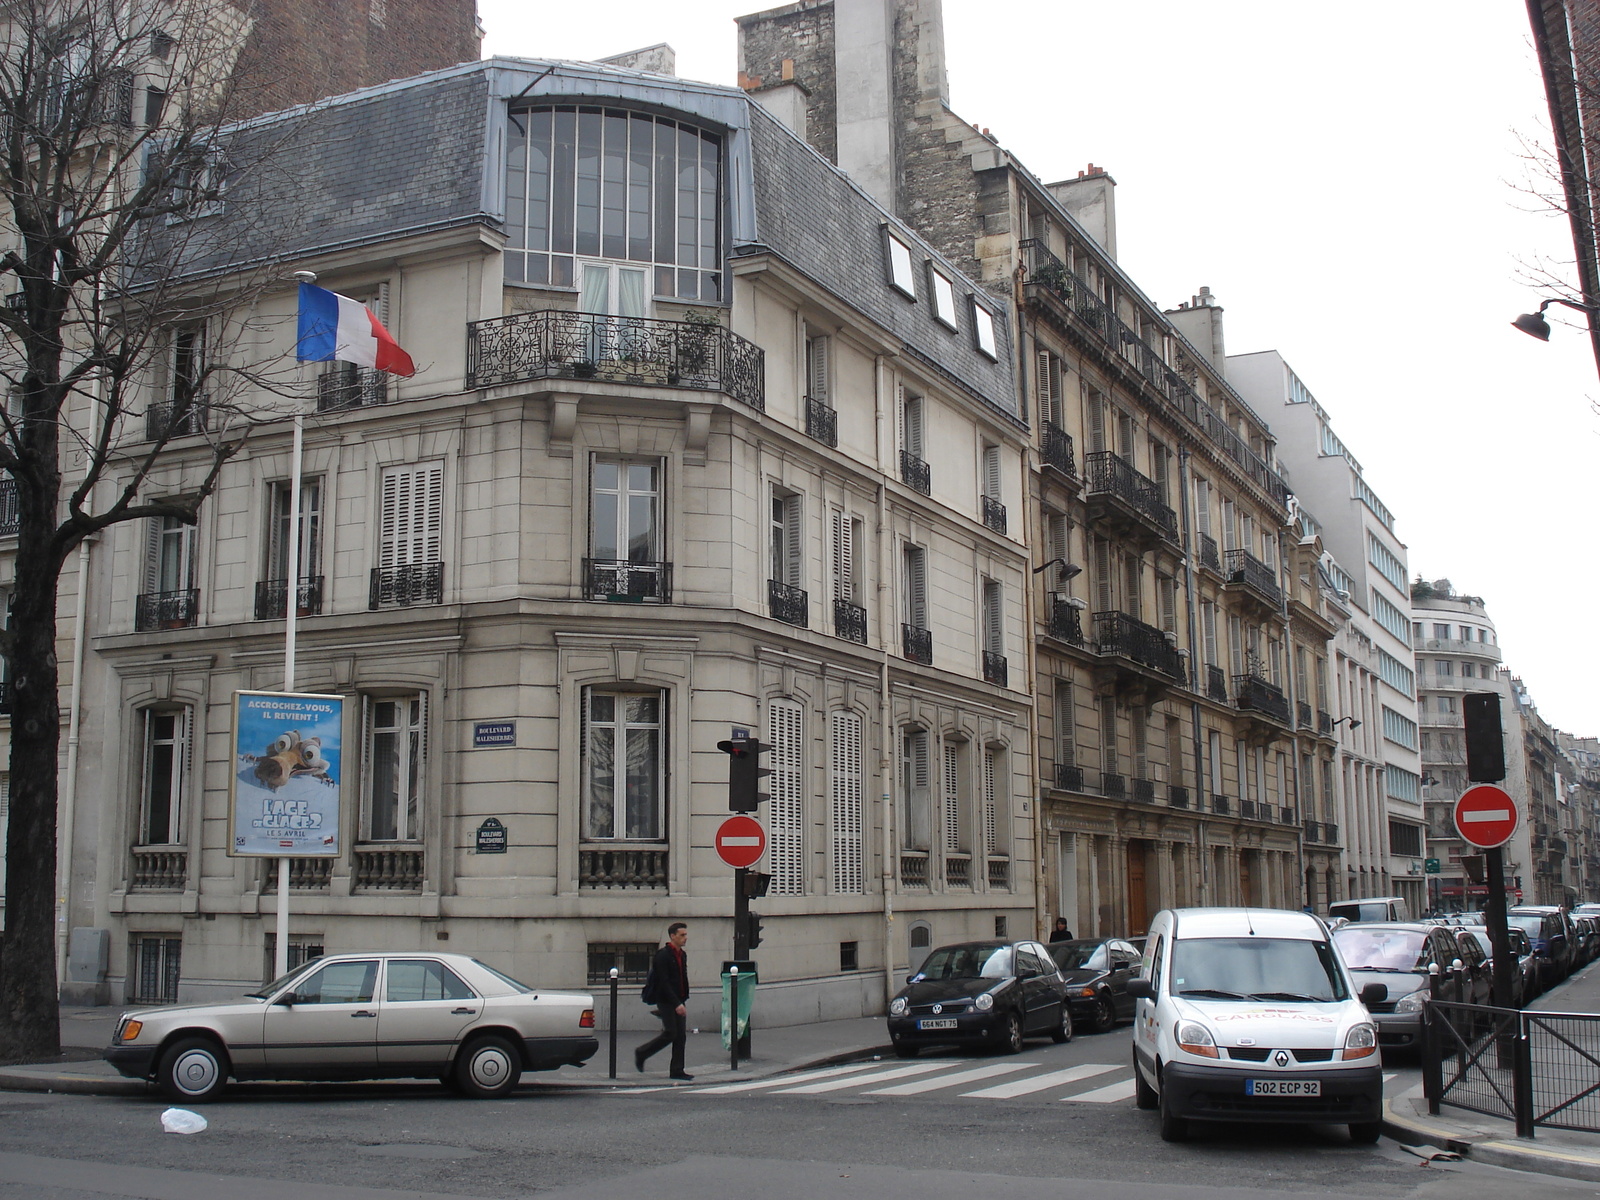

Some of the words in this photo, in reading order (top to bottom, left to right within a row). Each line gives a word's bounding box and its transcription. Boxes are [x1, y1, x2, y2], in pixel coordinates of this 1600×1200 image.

[248, 701, 334, 713] ACCROCHEZ-VOUS,
[263, 711, 272, 719] IL
[274, 712, 312, 721] REVIENT
[314, 713, 319, 722] !
[479, 726, 512, 734] BOULEVARD
[1214, 1013, 1334, 1024] CARGLASS
[1255, 1082, 1276, 1094] 502
[1279, 1082, 1301, 1094] ECP
[1303, 1082, 1318, 1094] 92
